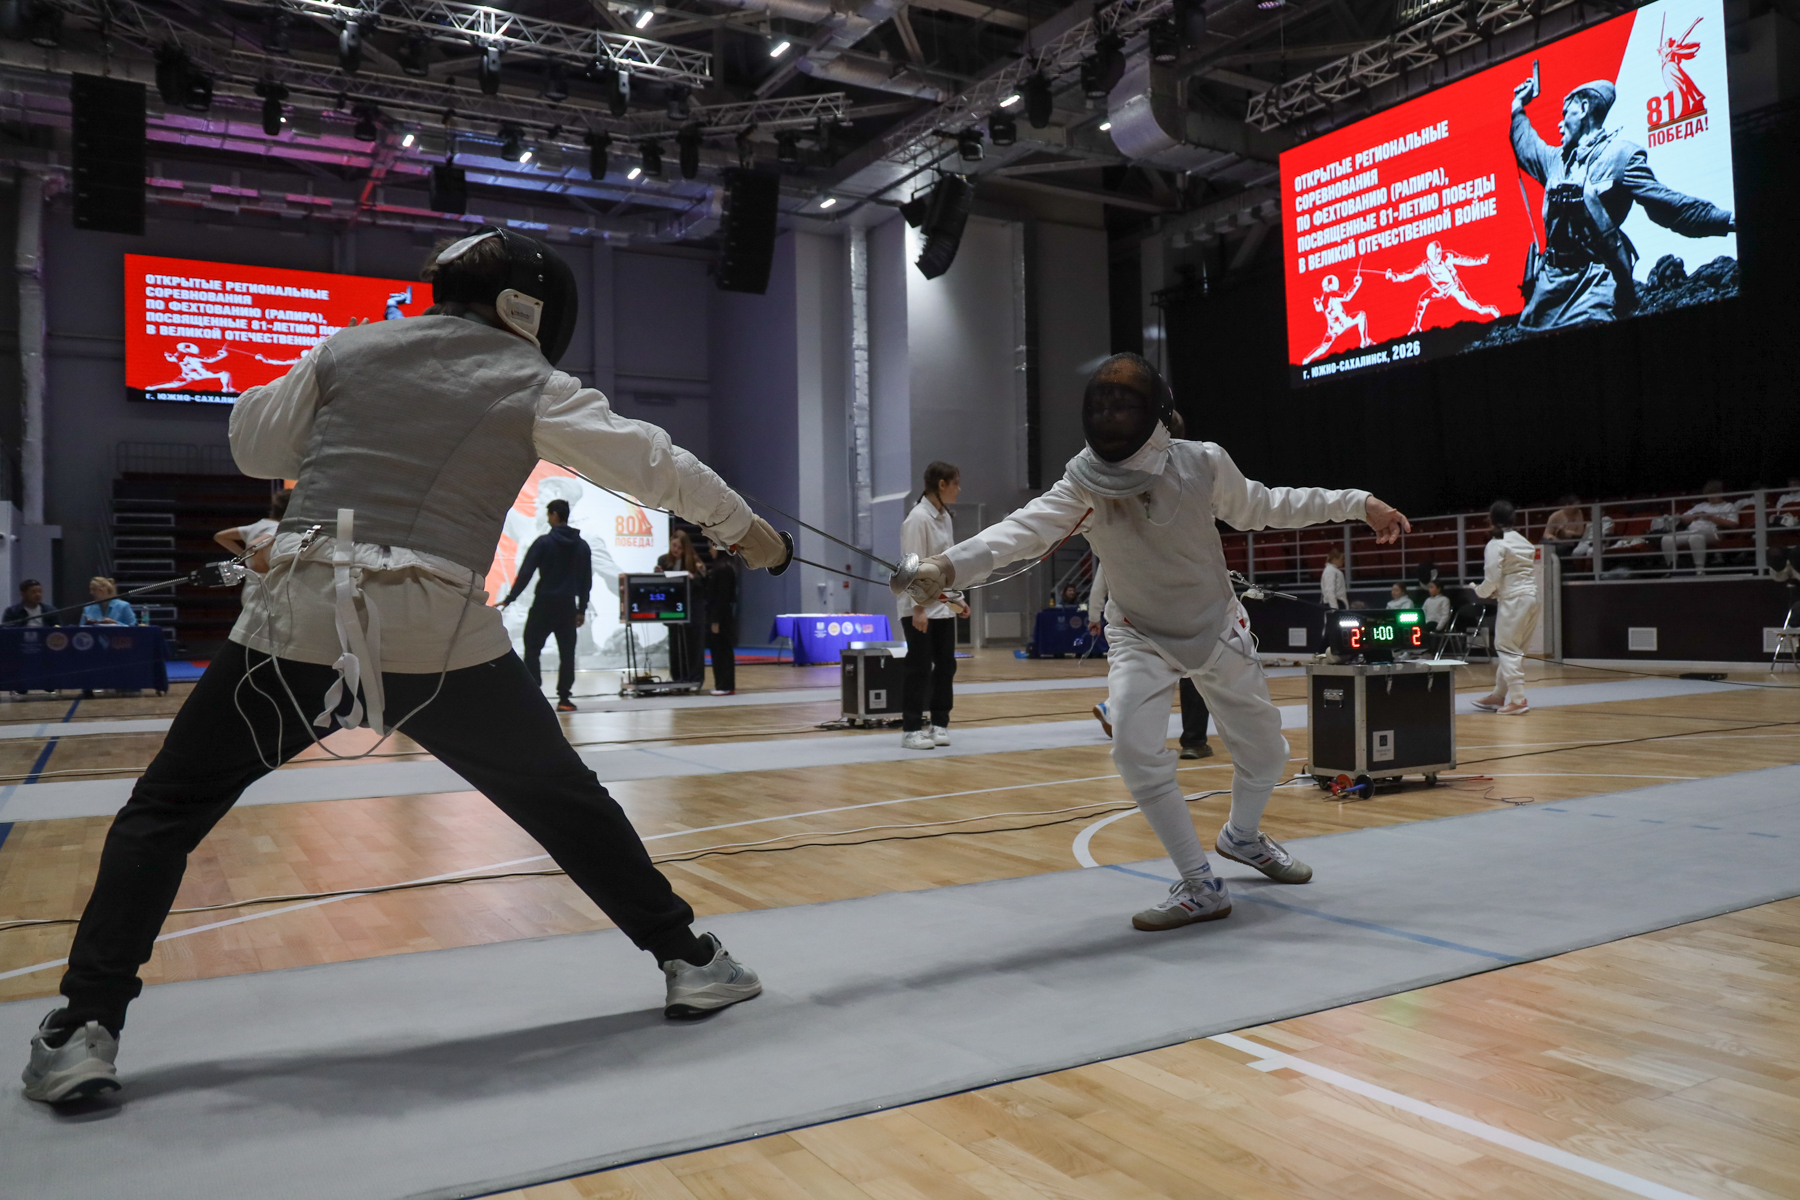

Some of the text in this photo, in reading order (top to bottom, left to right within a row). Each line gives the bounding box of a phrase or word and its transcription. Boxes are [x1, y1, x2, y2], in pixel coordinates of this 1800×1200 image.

[1647, 90, 1675, 126] 81
[1648, 116, 1709, 149] ПОБЕДА!
[1294, 120, 1450, 192] ОТКРЫТЫЕ РЕГИОНАЛЬНЫЕ
[1295, 168, 1379, 212] СОРЕВНОВАНИЯ
[1296, 167, 1450, 233] ПО ФЕХТОВАНИЮ (РАПИРА),
[1297, 173, 1496, 254] ПОСВЯЩЕННЫЕ 81-ЛЕТИЮ ПОБЕДЫ
[1298, 197, 1498, 274] В ВЕЛИКОЙ ОТЕЧЕСТВЕННОЙ ВОЙНЕ
[145, 273, 330, 300] ОТКРЫТЫЕ РЕГИОНАЛЬНЫЕ
[145, 286, 253, 305] СОРЕВНОВАНИЯ
[145, 298, 328, 325] ПО ФЕХТОВАНИЮ (РАПИРА),
[145, 311, 249, 330] ПОСВЯЩЕННЫЕ
[251, 319, 317, 335] 81-ЛЕТИЮ
[146, 324, 157, 335] В
[159, 325, 222, 340] ВЕЛИКОЙ
[1302, 340, 1421, 380] г. ЮЖНО-САХАЛИНСК, 2026
[615, 515, 636, 534] 80
[615, 537, 654, 548] ПОБЕДА!
[631, 602, 683, 612] 1 3
[1351, 626, 1421, 648] 2 1:00 2
